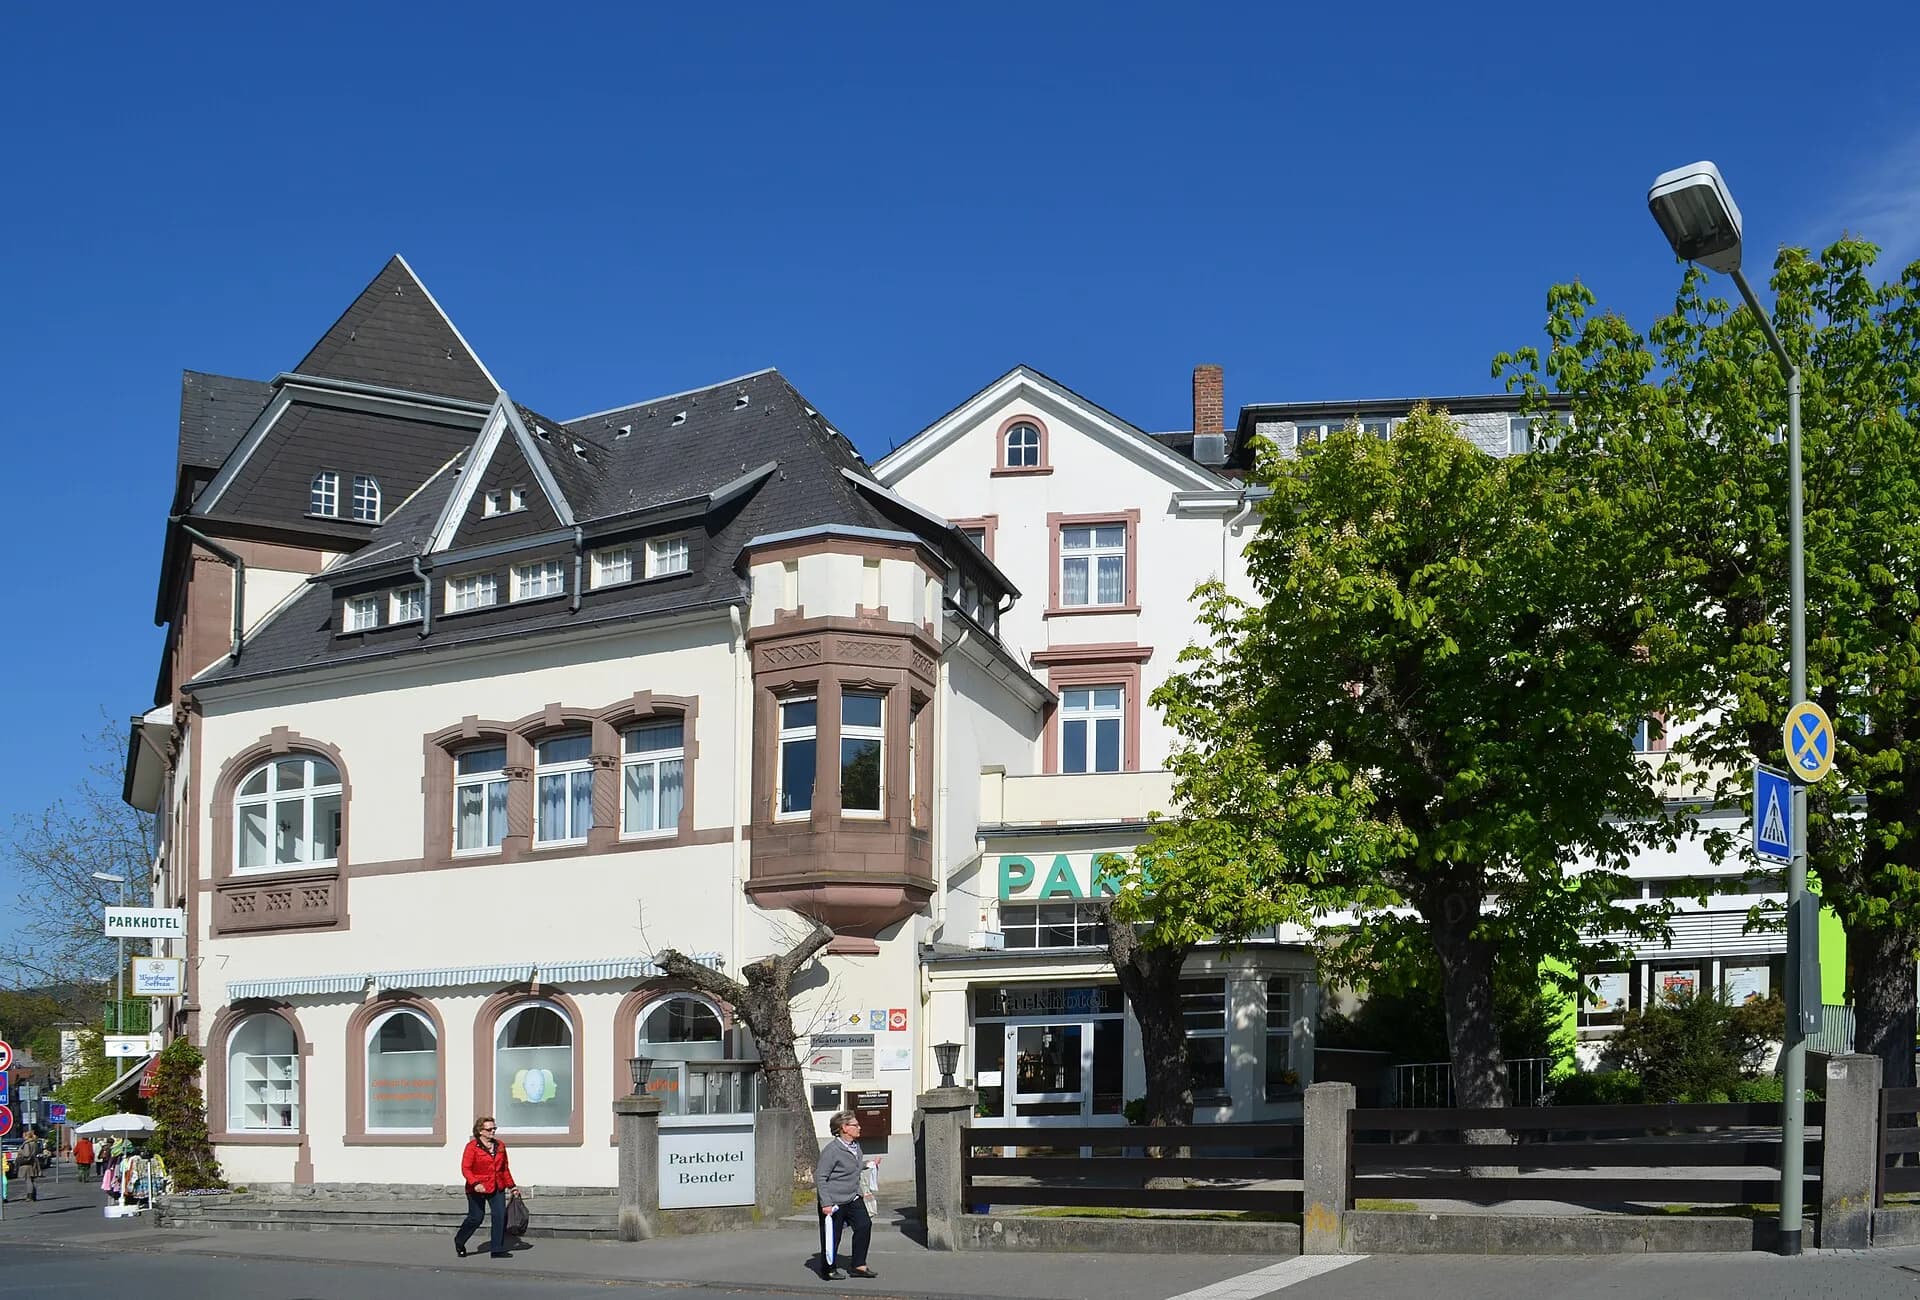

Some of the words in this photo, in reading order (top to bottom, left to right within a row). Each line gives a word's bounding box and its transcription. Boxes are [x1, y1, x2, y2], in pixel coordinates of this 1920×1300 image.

[108, 916, 179, 929] PARKHOTEL
[669, 1151, 743, 1164] Parkhotel
[679, 1171, 735, 1184] Bender
